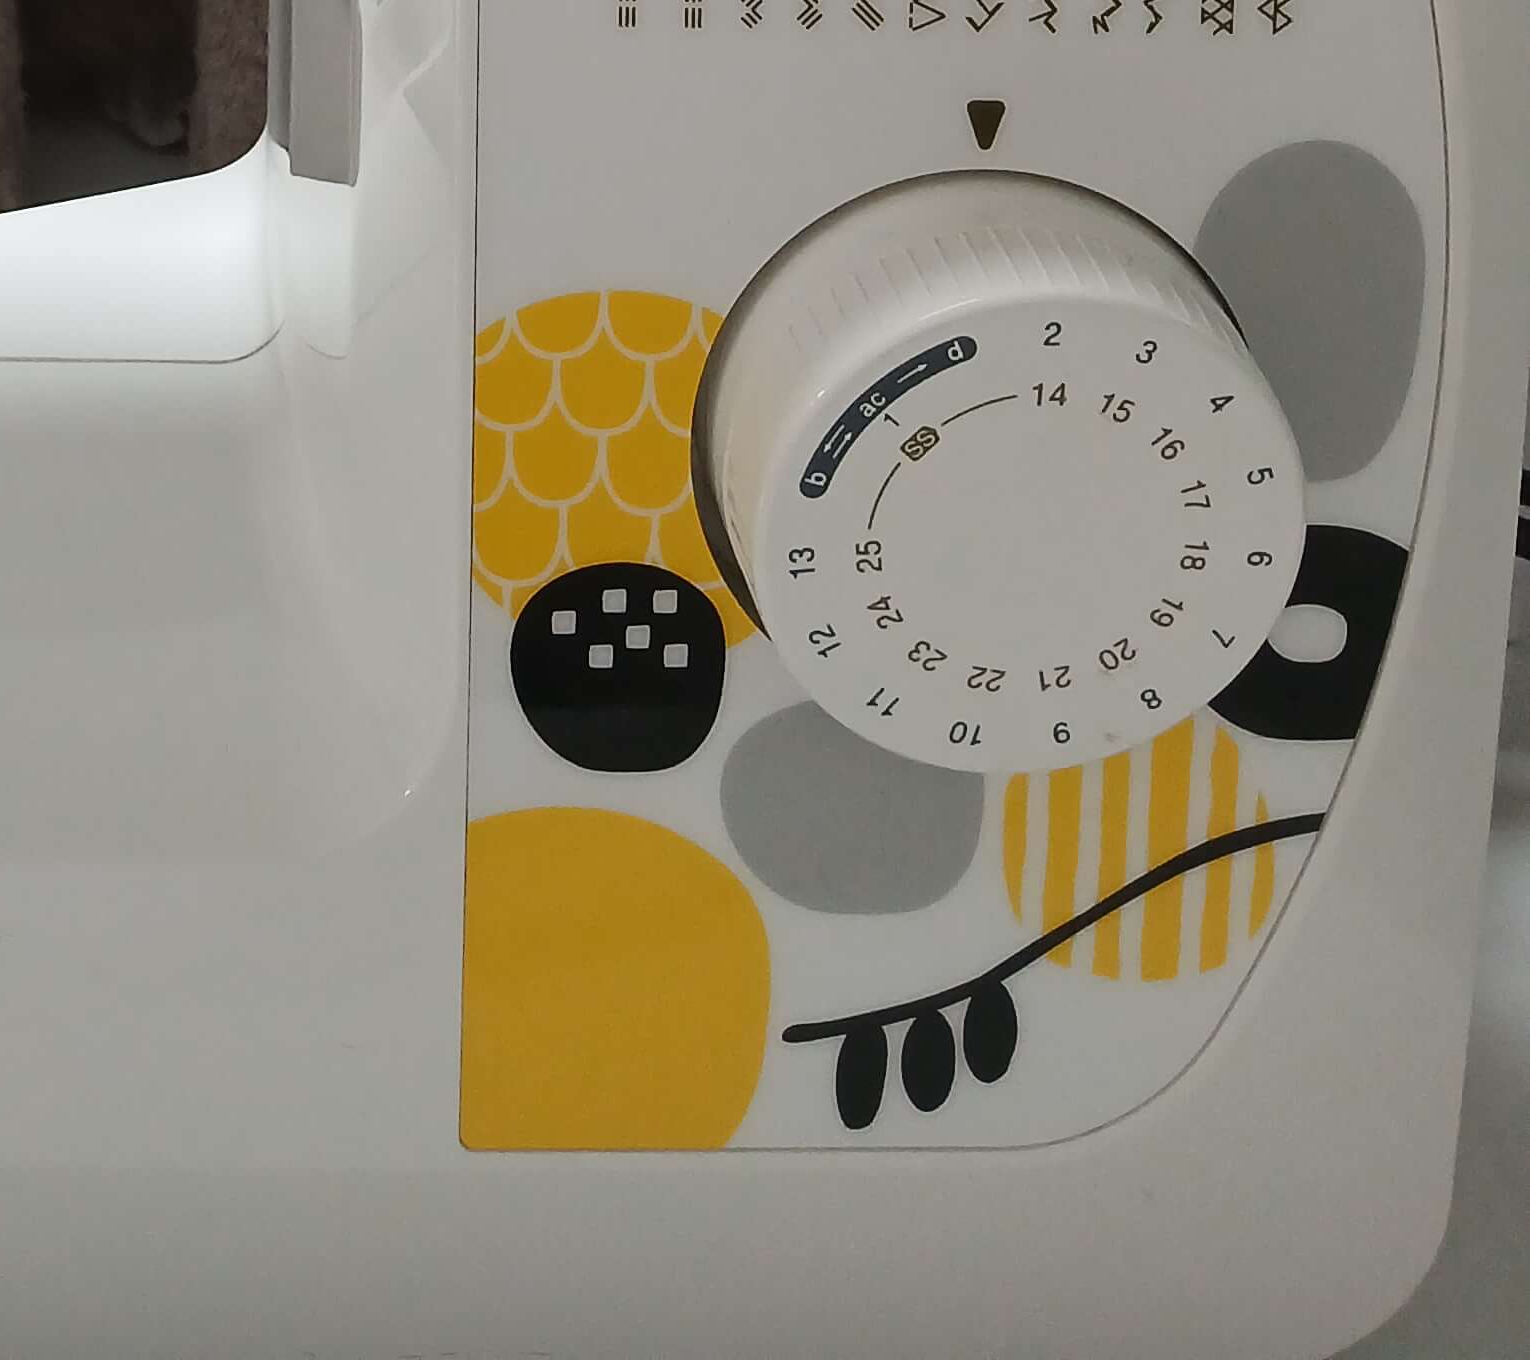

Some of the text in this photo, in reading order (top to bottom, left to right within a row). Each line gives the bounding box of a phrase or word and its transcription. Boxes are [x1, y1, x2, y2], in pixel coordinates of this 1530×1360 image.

[806, 341, 964, 488] b ac d
[903, 429, 937, 459] SS
[789, 322, 1273, 745] 2 3 4 5 6 7 8 9 10 11 12 13
[856, 383, 1211, 692] 14 15 16 17 18 19 20 21 22 23 24 25
